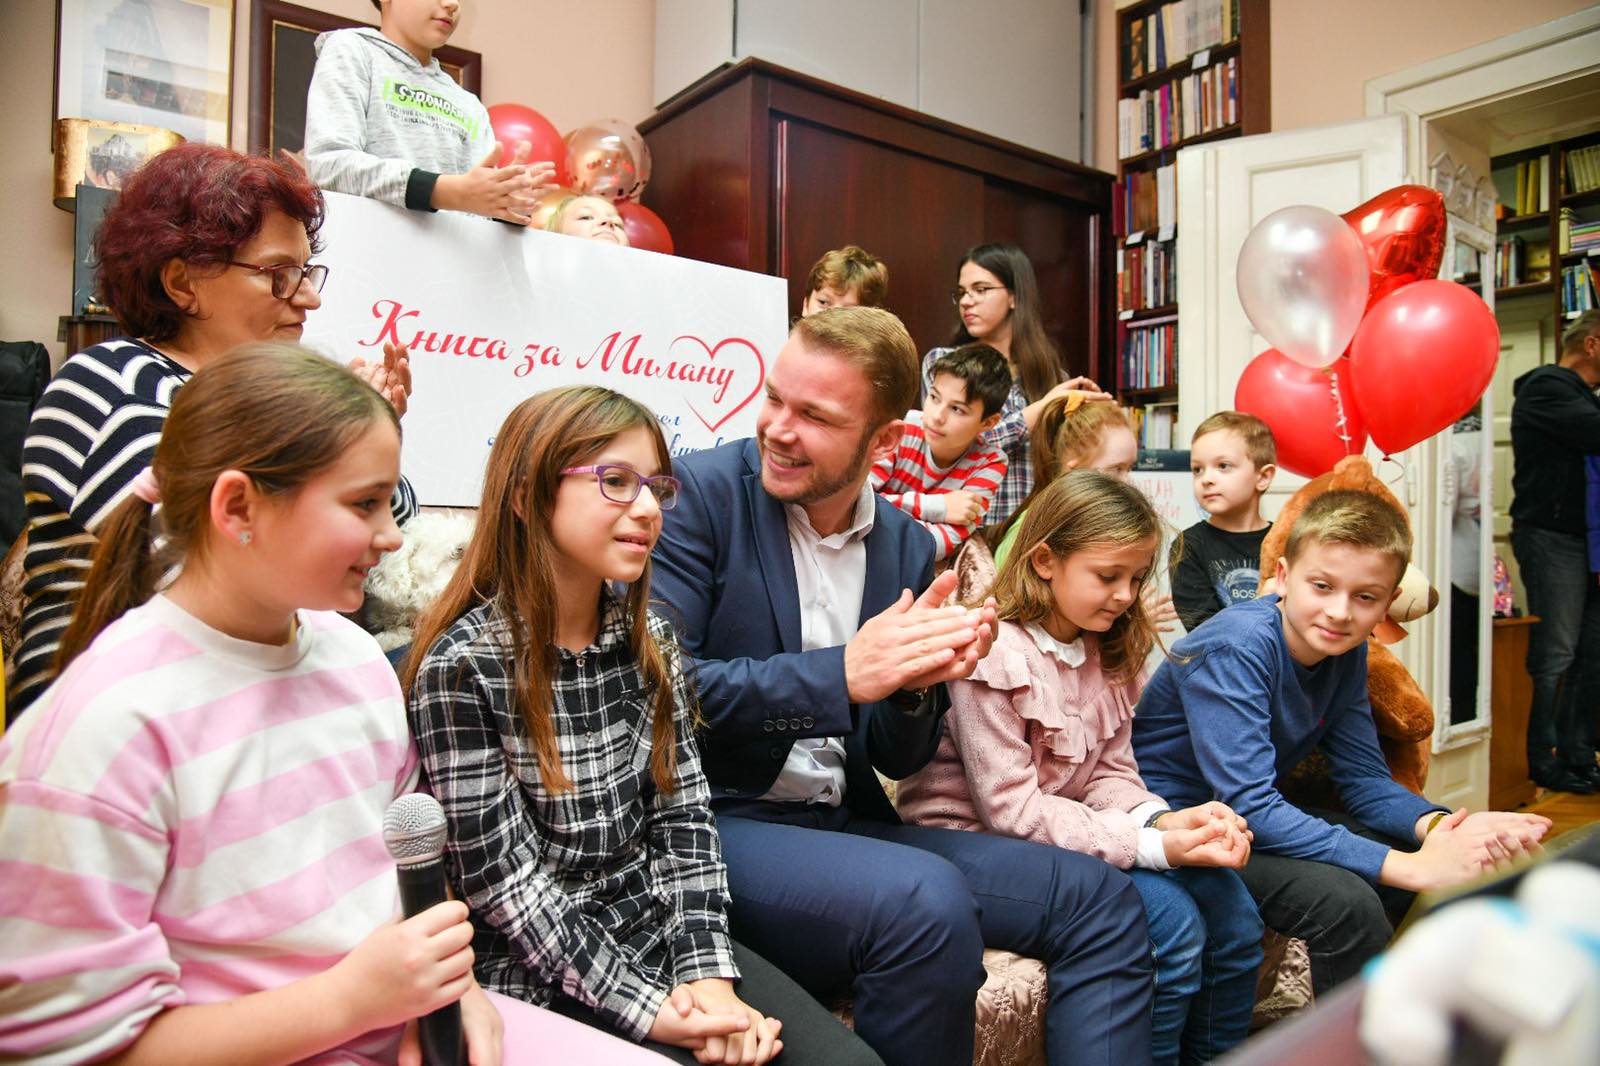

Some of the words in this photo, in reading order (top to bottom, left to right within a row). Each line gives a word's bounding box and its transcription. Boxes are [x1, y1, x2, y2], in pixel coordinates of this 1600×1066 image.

[515, 342, 566, 378] за
[576, 331, 735, 405] Милану
[1231, 588, 1257, 599] BOS
